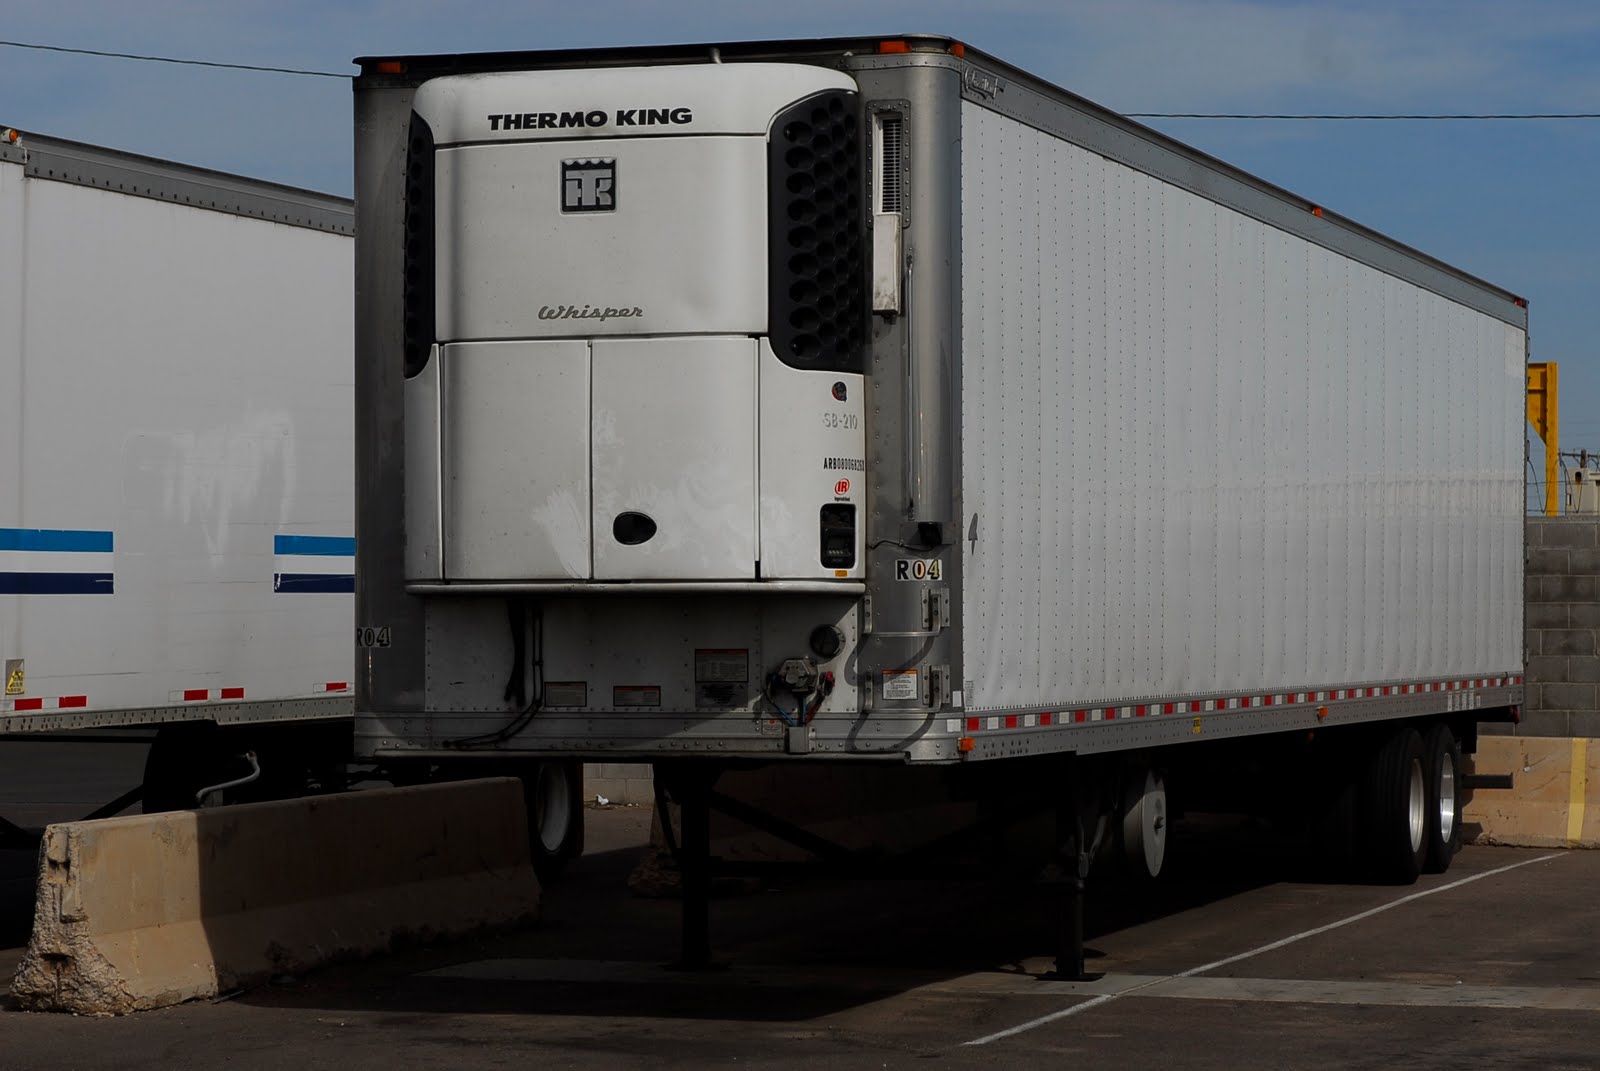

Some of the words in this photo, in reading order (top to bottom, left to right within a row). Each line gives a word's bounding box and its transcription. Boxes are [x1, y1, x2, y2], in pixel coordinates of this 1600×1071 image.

[488, 110, 608, 130] THERMO
[616, 108, 692, 126] KING
[538, 304, 643, 322] Whisper
[822, 412, 858, 430] SB-210
[897, 559, 940, 580] R04
